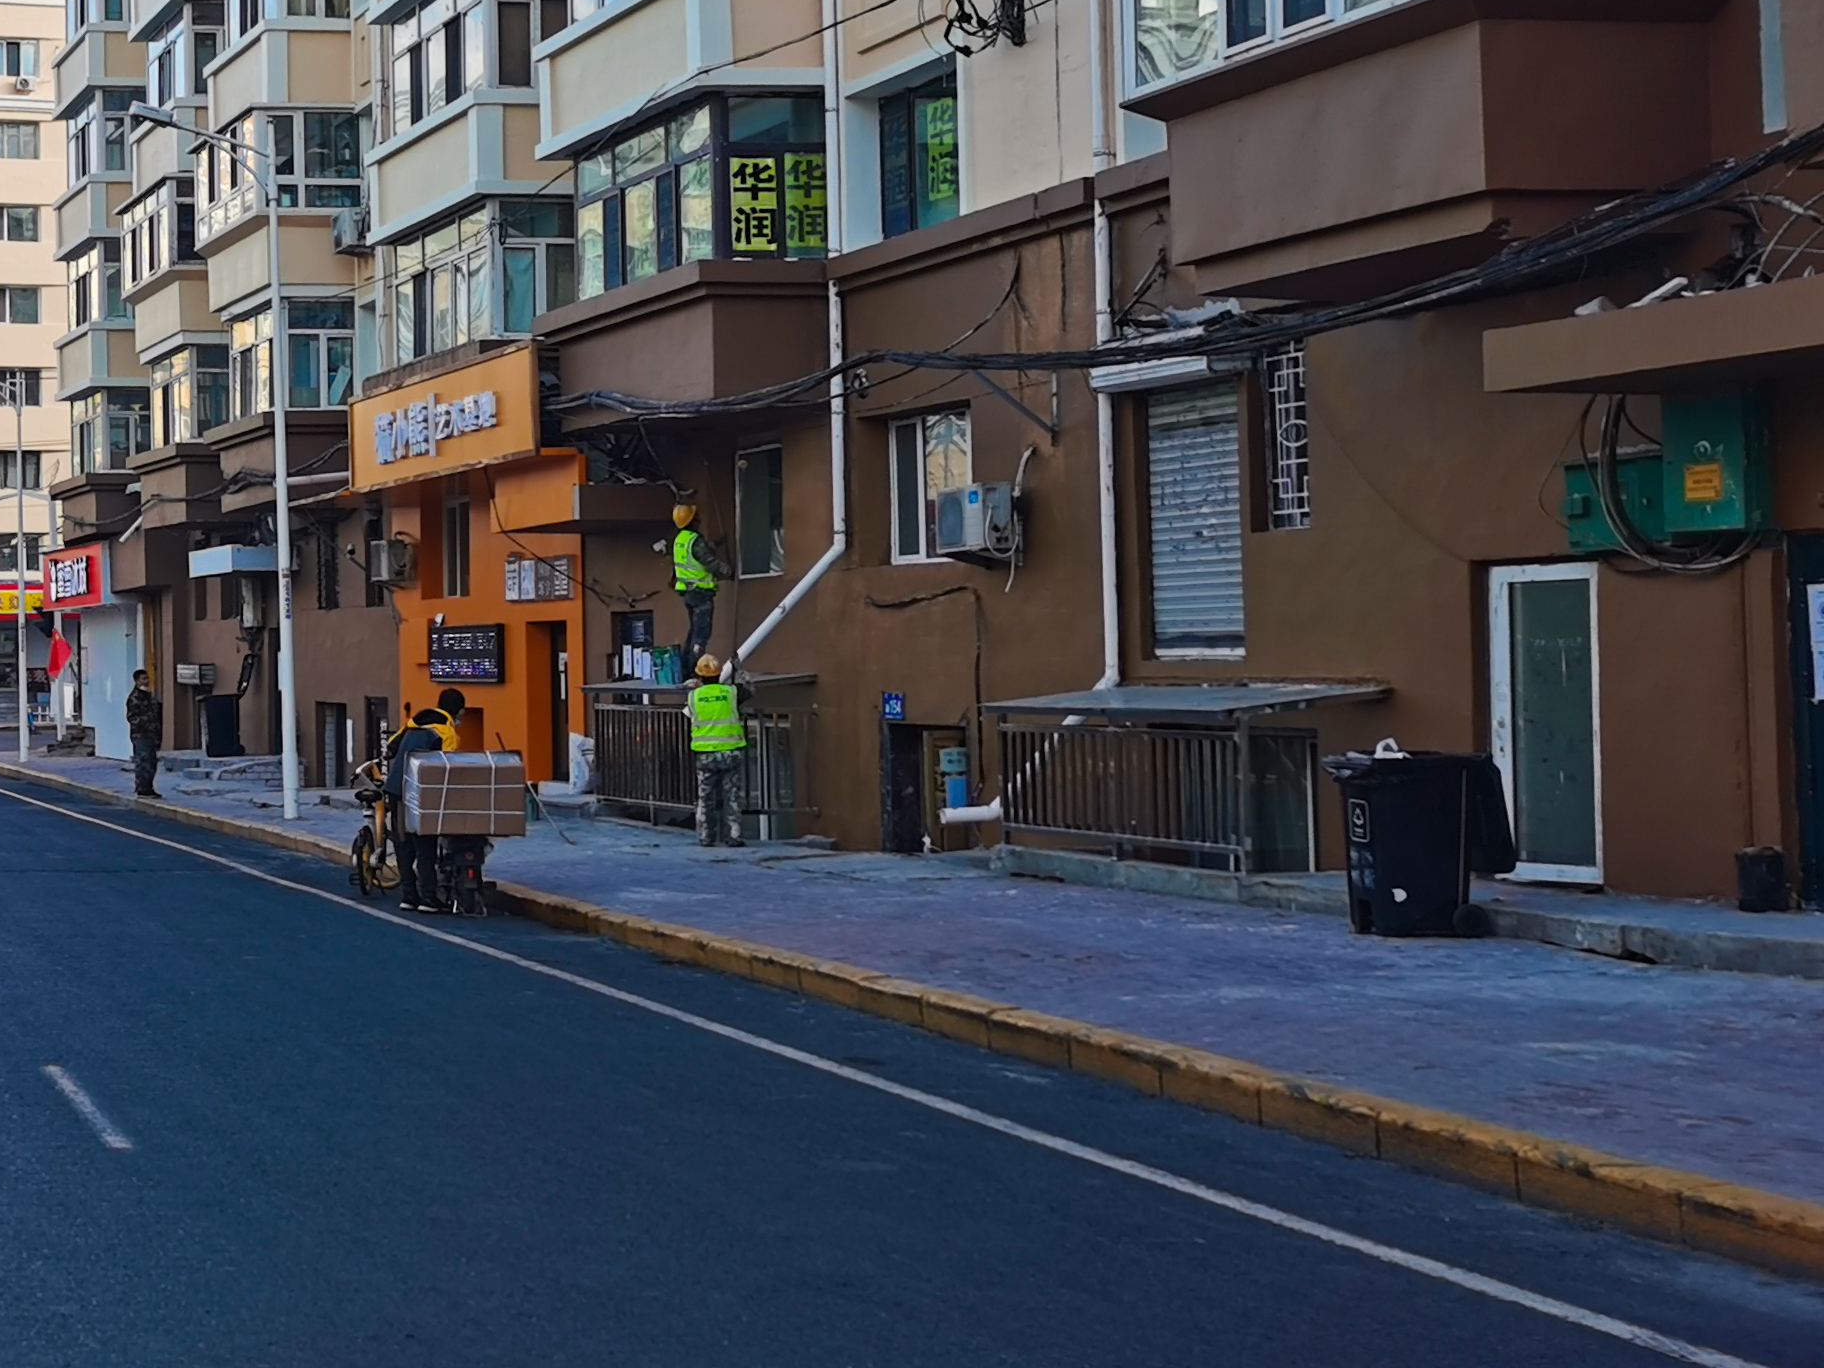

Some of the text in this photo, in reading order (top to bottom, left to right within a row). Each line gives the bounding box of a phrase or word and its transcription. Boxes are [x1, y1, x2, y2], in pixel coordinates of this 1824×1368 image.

[929, 101, 956, 195] 华润
[732, 162, 776, 246] 华润
[786, 159, 825, 244] 华润
